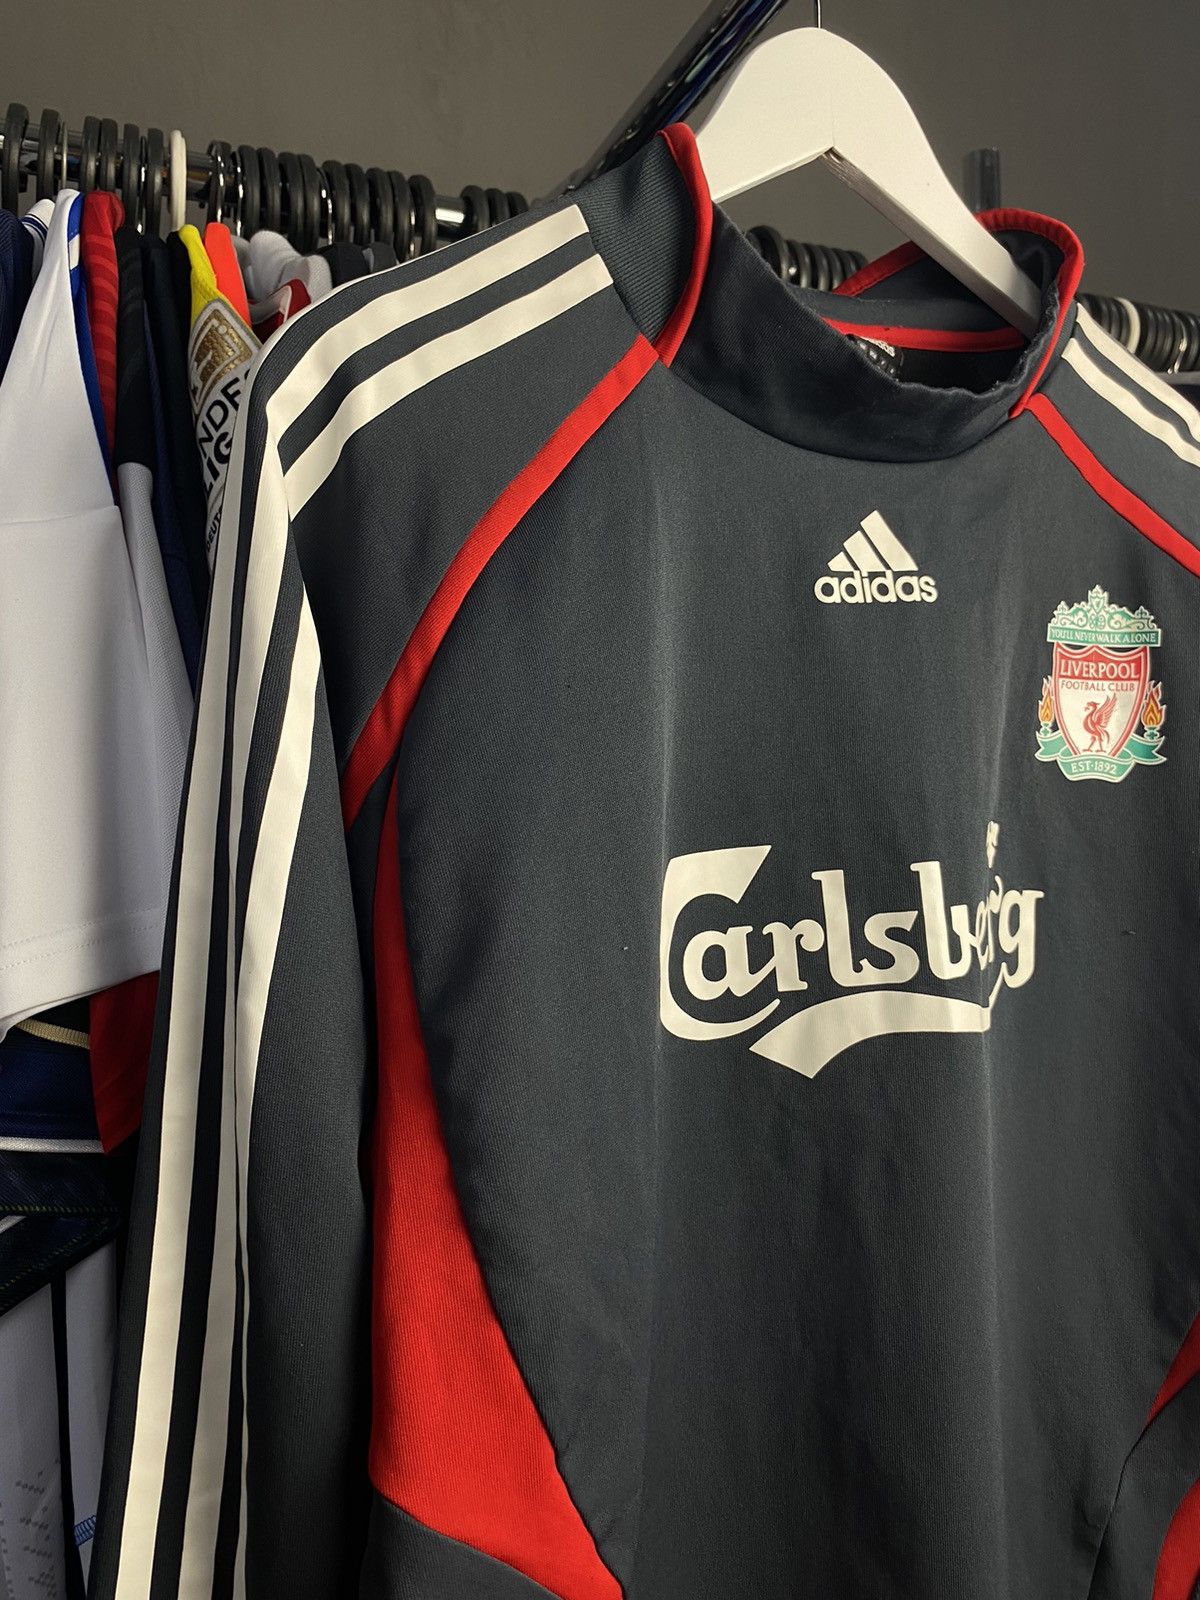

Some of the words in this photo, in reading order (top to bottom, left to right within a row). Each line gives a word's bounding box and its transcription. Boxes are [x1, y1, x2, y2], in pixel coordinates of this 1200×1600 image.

[814, 569, 938, 604] adidas
[1097, 632, 1121, 643] WALK
[1122, 632, 1156, 643] ALONE
[1060, 659, 1140, 679] LIVERPOOL
[1061, 680, 1105, 692] FOOTBALL
[1107, 682, 1136, 692] CLUB
[660, 844, 1045, 1078] Carlsberg
